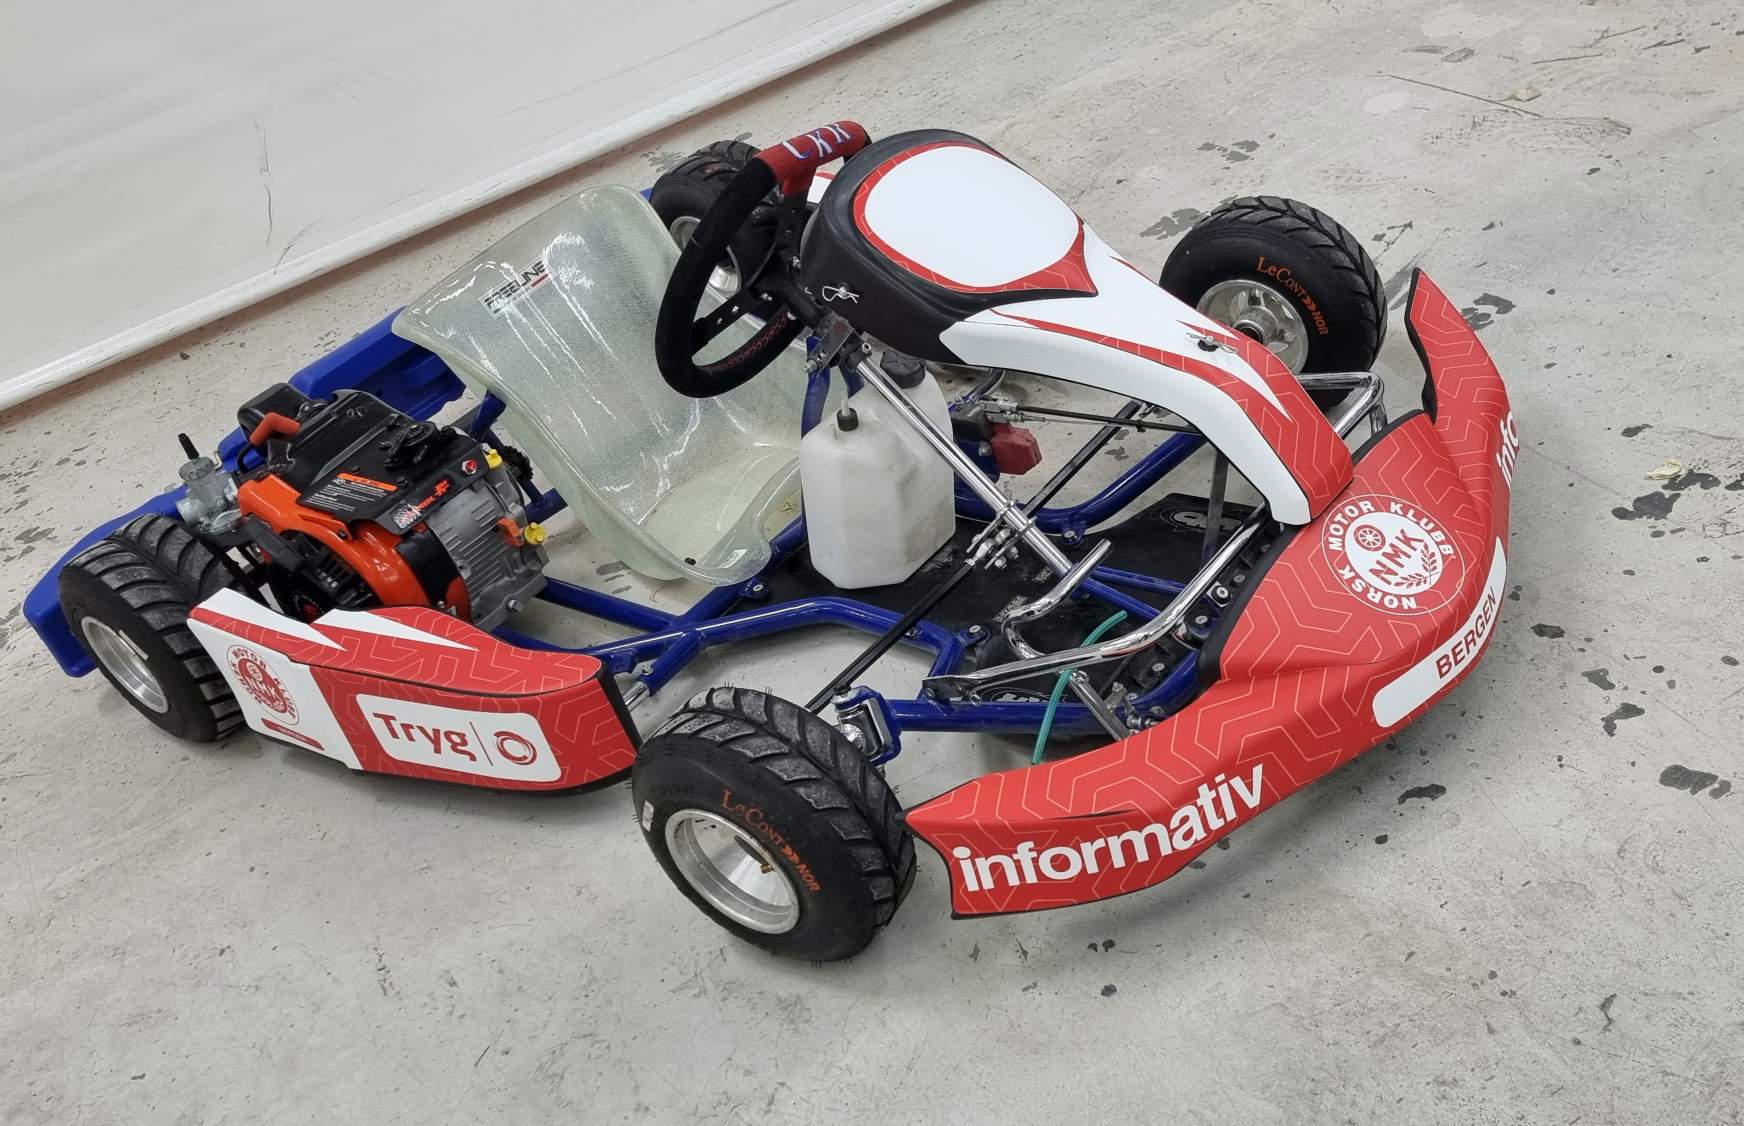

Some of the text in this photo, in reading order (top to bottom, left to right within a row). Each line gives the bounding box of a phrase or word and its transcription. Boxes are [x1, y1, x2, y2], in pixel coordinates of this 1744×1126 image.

[1328, 500, 1454, 609] NORSK MOTOR KLUBB
[1368, 528, 1424, 586] NMK
[232, 648, 267, 671] MOTOR
[1436, 587, 1497, 680] BERGEN
[372, 712, 478, 762] Tryg
[952, 764, 1264, 892] informativ
